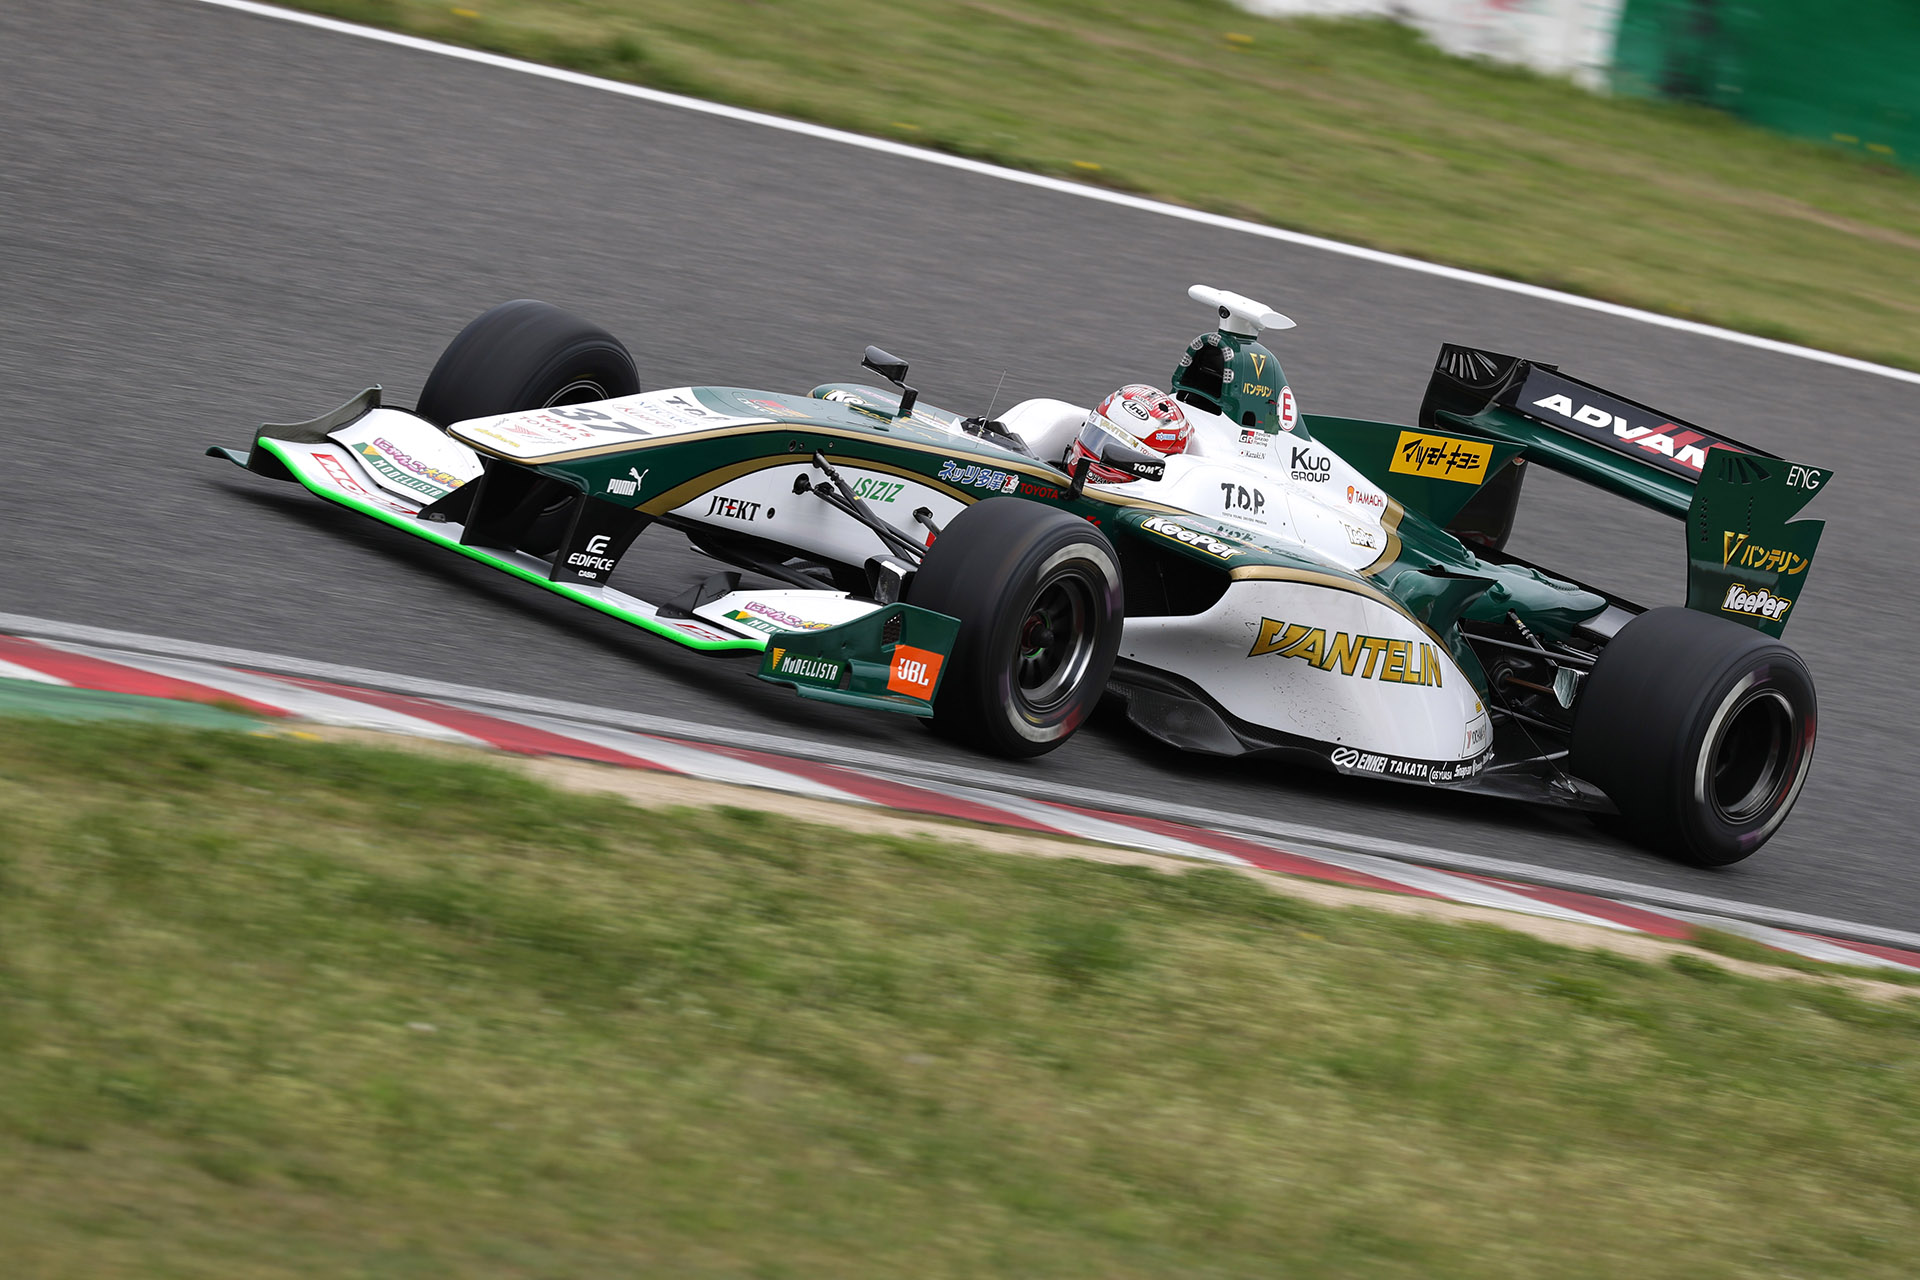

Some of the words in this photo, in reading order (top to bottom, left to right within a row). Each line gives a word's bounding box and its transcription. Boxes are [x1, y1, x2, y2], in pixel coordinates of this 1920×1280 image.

[1243, 383, 1273, 398] バンテリン
[1283, 393, 1293, 421] E
[548, 408, 652, 435] 37
[372, 459, 444, 497] MODELLISTA
[606, 478, 638, 496] PUMA
[1290, 470, 1331, 483] GROUP
[1786, 465, 1820, 490] ENG
[1020, 483, 1060, 499] TOYOTA
[704, 495, 762, 521] JTEKT
[1143, 517, 1242, 558] KeePer
[567, 552, 615, 571] EDIFICE
[1740, 545, 1808, 575] バンテリン
[578, 570, 597, 579] CASIO
[1723, 585, 1789, 619] KeePer
[1247, 616, 1443, 688] VANTELIN
[897, 657, 930, 686] JBL
[1356, 753, 1389, 773] ENKEI
[1389, 760, 1428, 778] TAKATA
